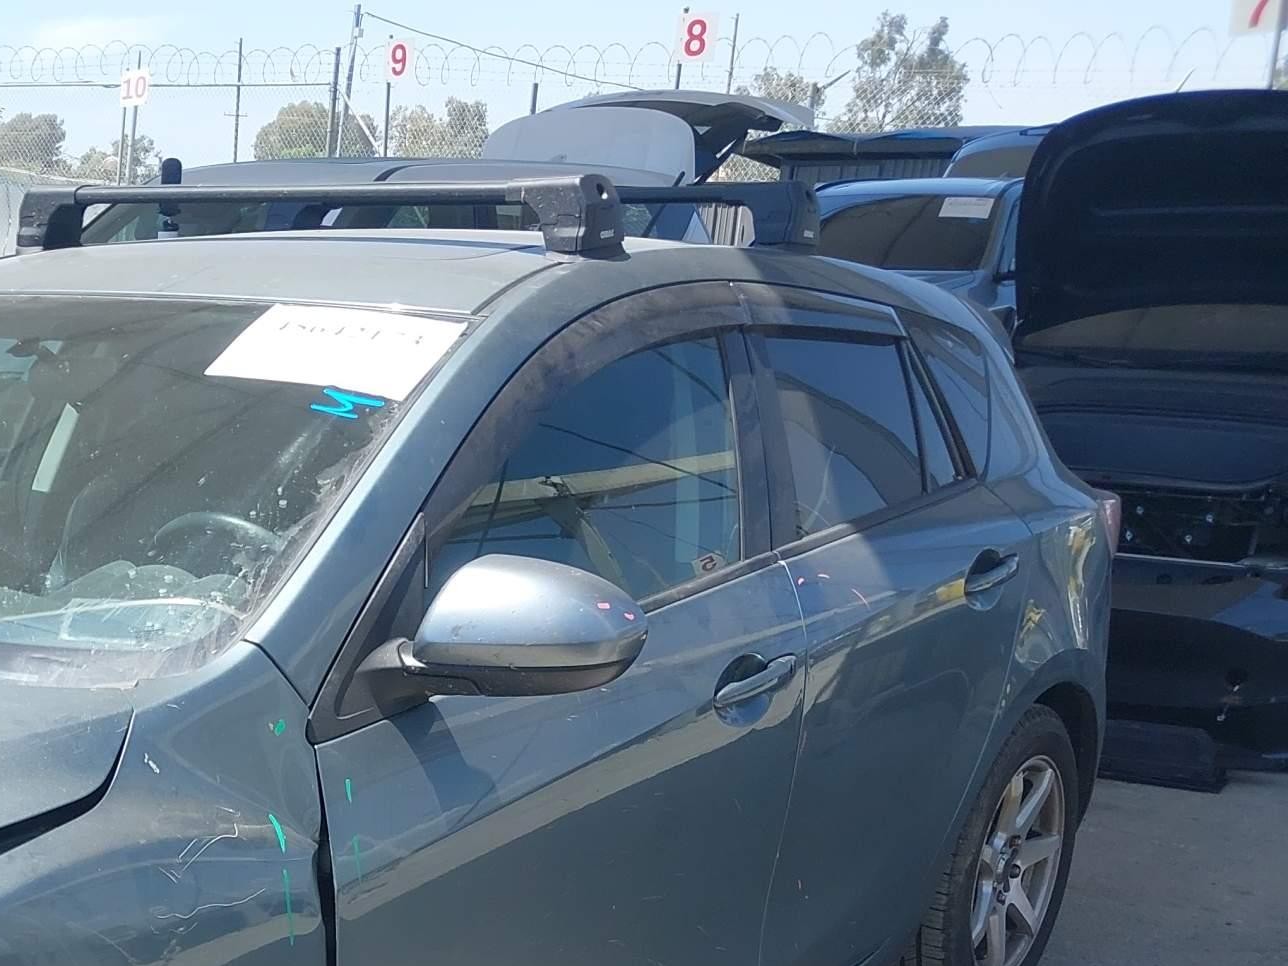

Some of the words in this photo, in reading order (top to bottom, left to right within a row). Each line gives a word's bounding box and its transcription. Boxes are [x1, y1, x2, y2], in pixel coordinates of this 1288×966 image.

[684, 19, 707, 56] 8
[391, 43, 406, 76] 9
[122, 76, 146, 100] 10
